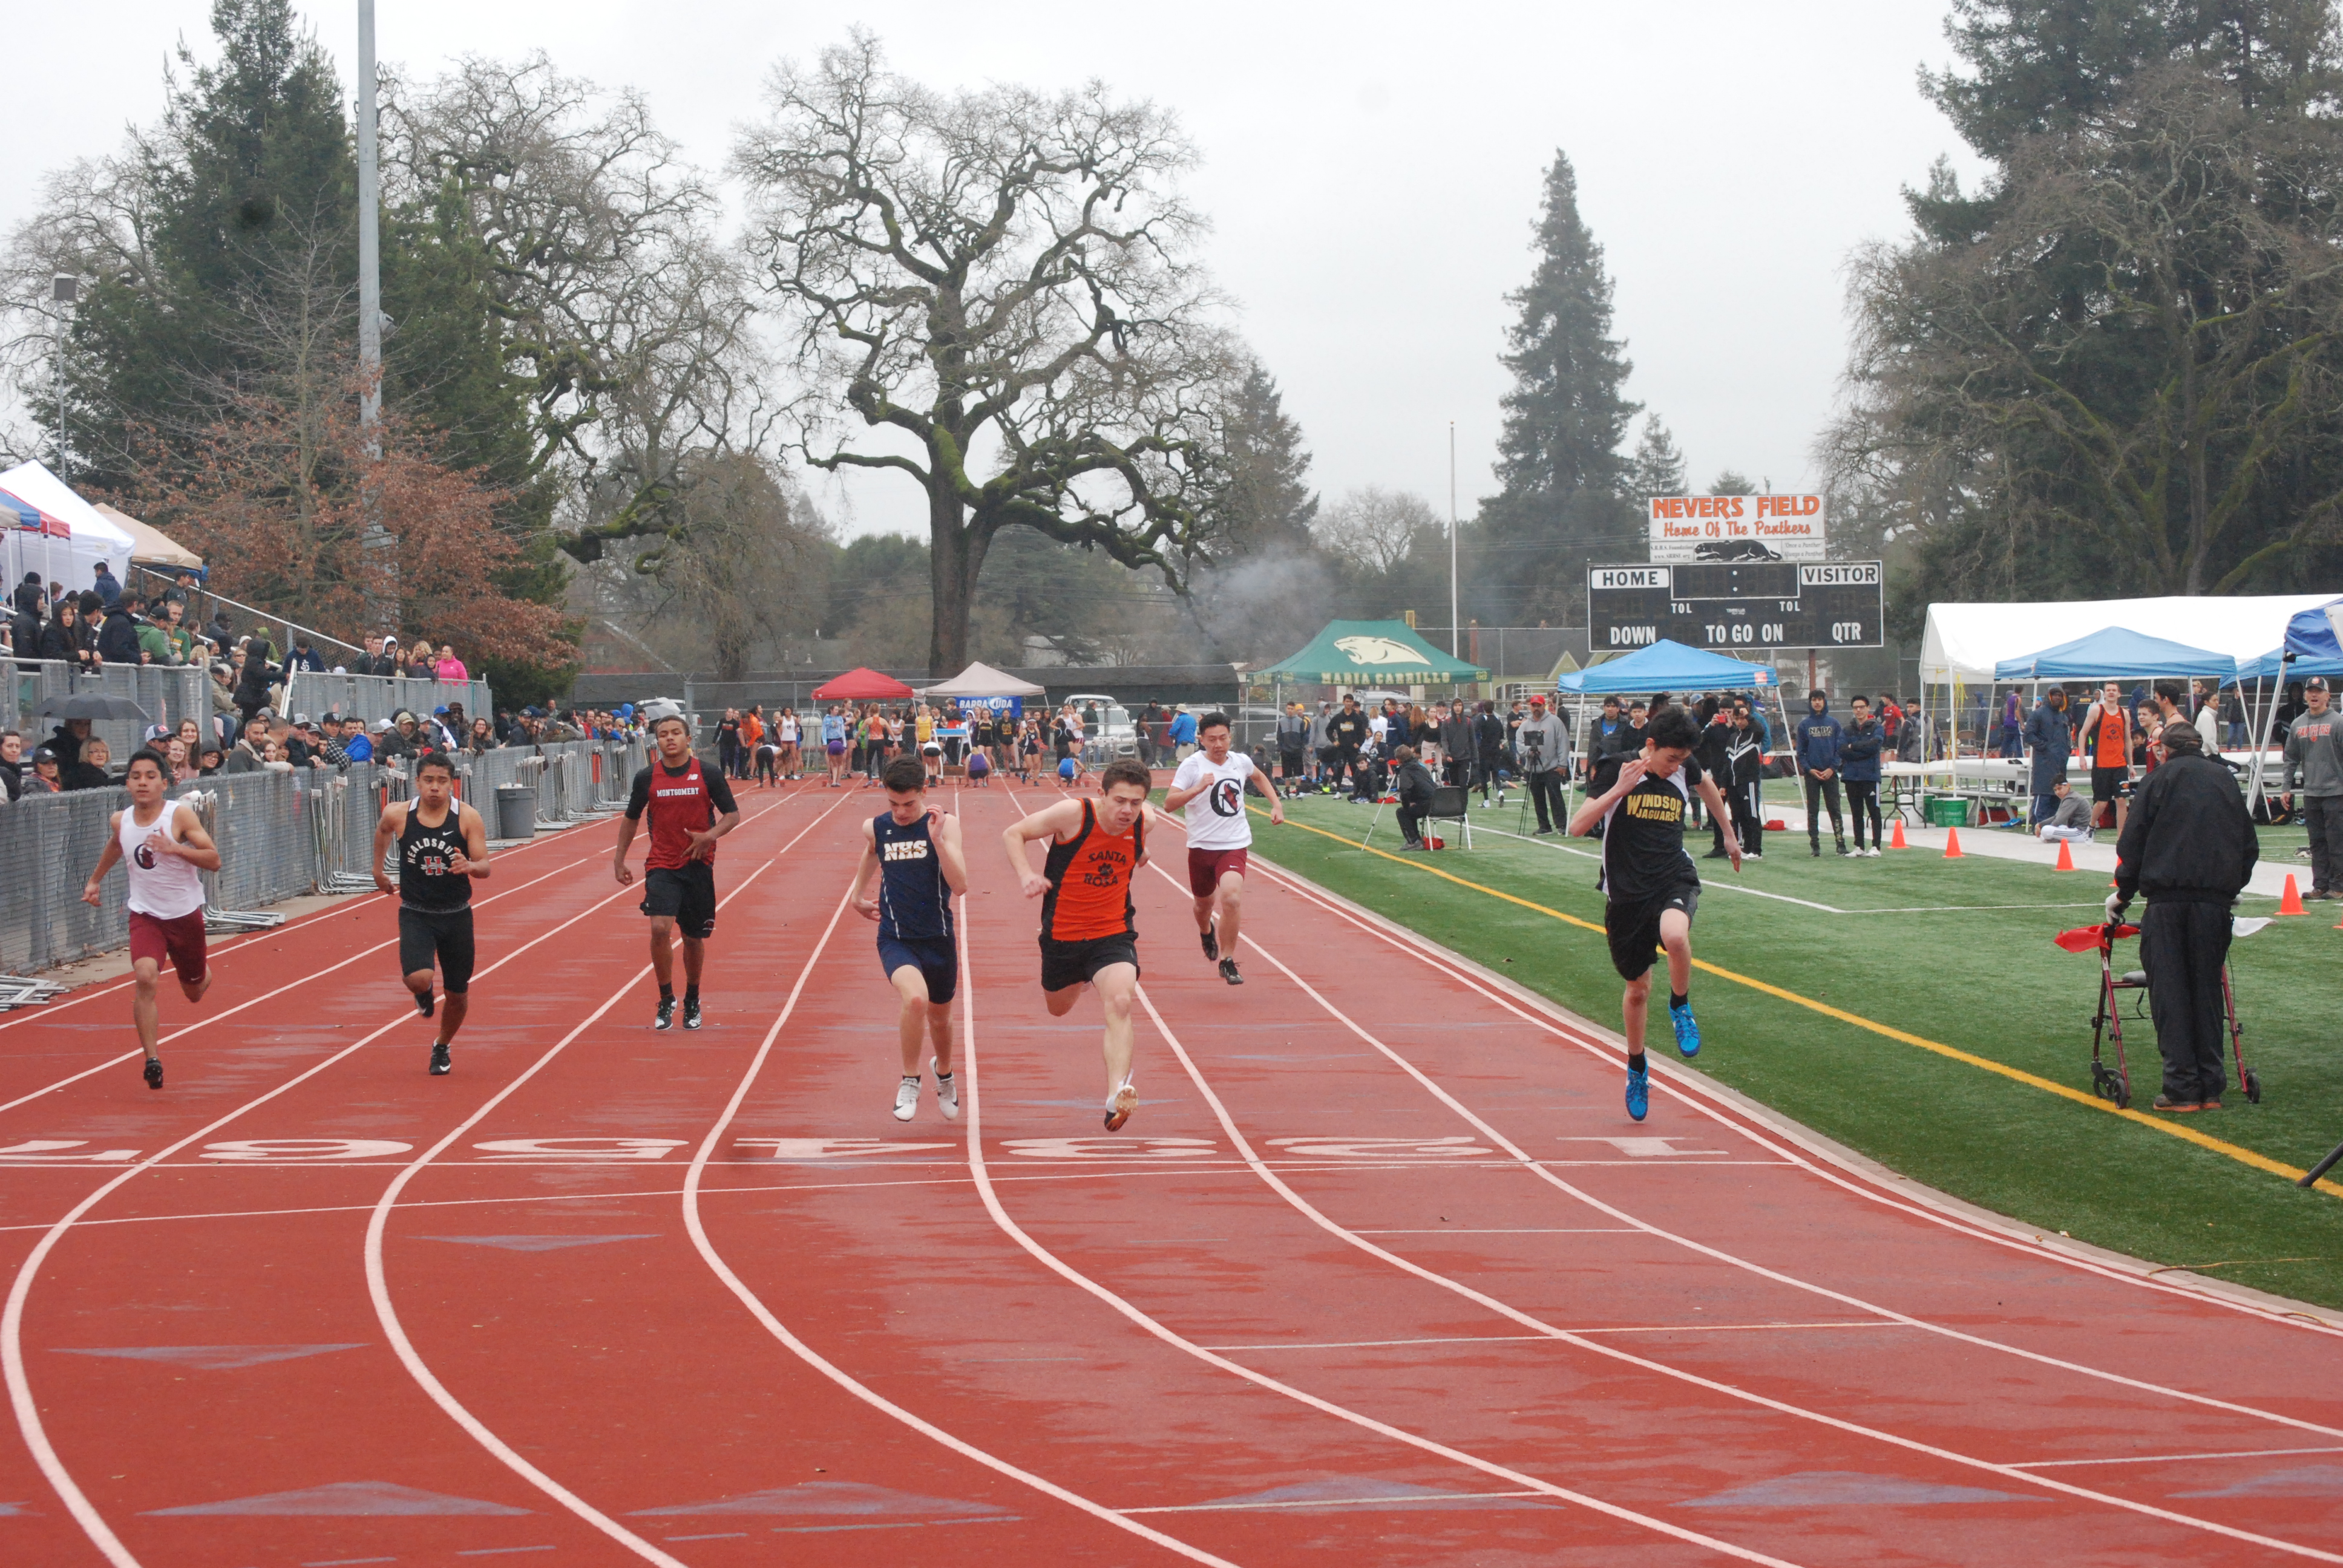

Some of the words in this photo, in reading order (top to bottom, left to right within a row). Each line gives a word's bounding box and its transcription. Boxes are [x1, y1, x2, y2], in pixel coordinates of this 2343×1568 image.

[1653, 497, 1744, 519] NEVERS
[1757, 496, 1820, 518] FIELD
[1664, 522, 1700, 537] Home
[1705, 521, 1720, 538] Of
[1726, 521, 1748, 536] The
[1754, 520, 1810, 535] Panthers
[1603, 571, 1658, 586] HOME
[1804, 567, 1876, 582] VISITOR
[1671, 603, 1692, 614] TOL
[1779, 601, 1800, 612] TOL
[1610, 626, 1656, 645] DOWN
[1706, 625, 1726, 643] TO
[1732, 624, 1753, 642] GO
[1761, 624, 1783, 642] ON
[1832, 622, 1861, 643] QTR
[1321, 672, 1370, 685] MARIA
[1375, 671, 1450, 684] CARRILLO
[1809, 726, 1832, 734] NAPA
[657, 787, 699, 797] MONTGOMERY
[1627, 794, 1682, 822] WINDSOR
[1636, 808, 1676, 822] JAGUARS
[884, 840, 928, 861] NHS
[1087, 850, 1127, 865] SANTA
[1084, 873, 1118, 887] ROSA
